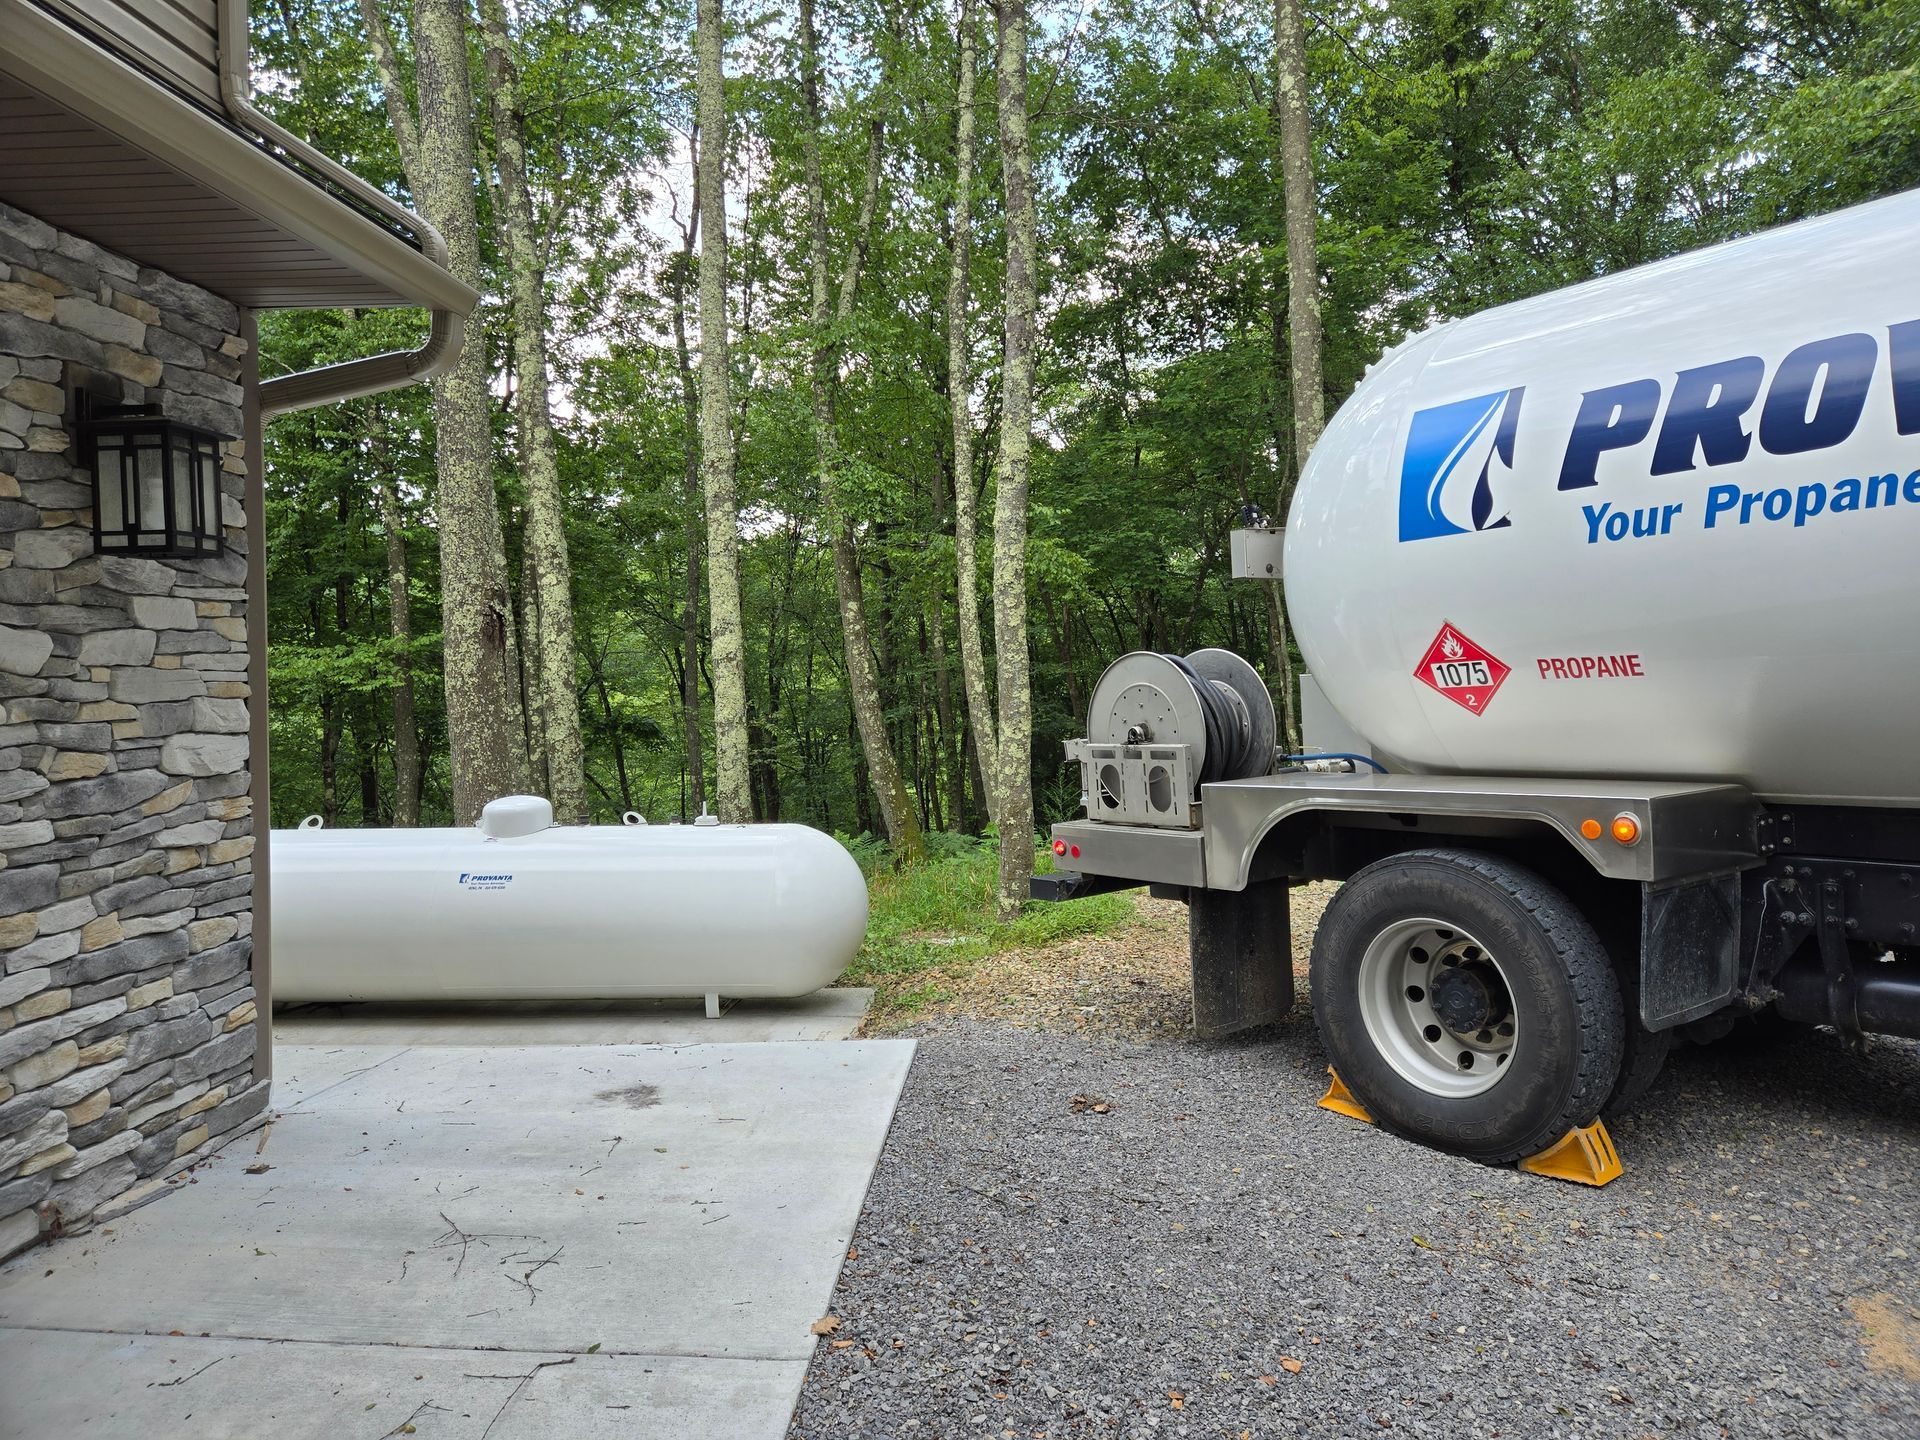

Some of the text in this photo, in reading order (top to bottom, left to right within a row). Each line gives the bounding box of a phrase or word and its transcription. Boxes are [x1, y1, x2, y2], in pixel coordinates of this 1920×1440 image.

[1557, 319, 1920, 491] PRO
[1582, 501, 1683, 544] Your
[1436, 661, 1489, 687] 1075
[1537, 654, 1645, 680] PROPANE
[1465, 693, 1478, 706] 2
